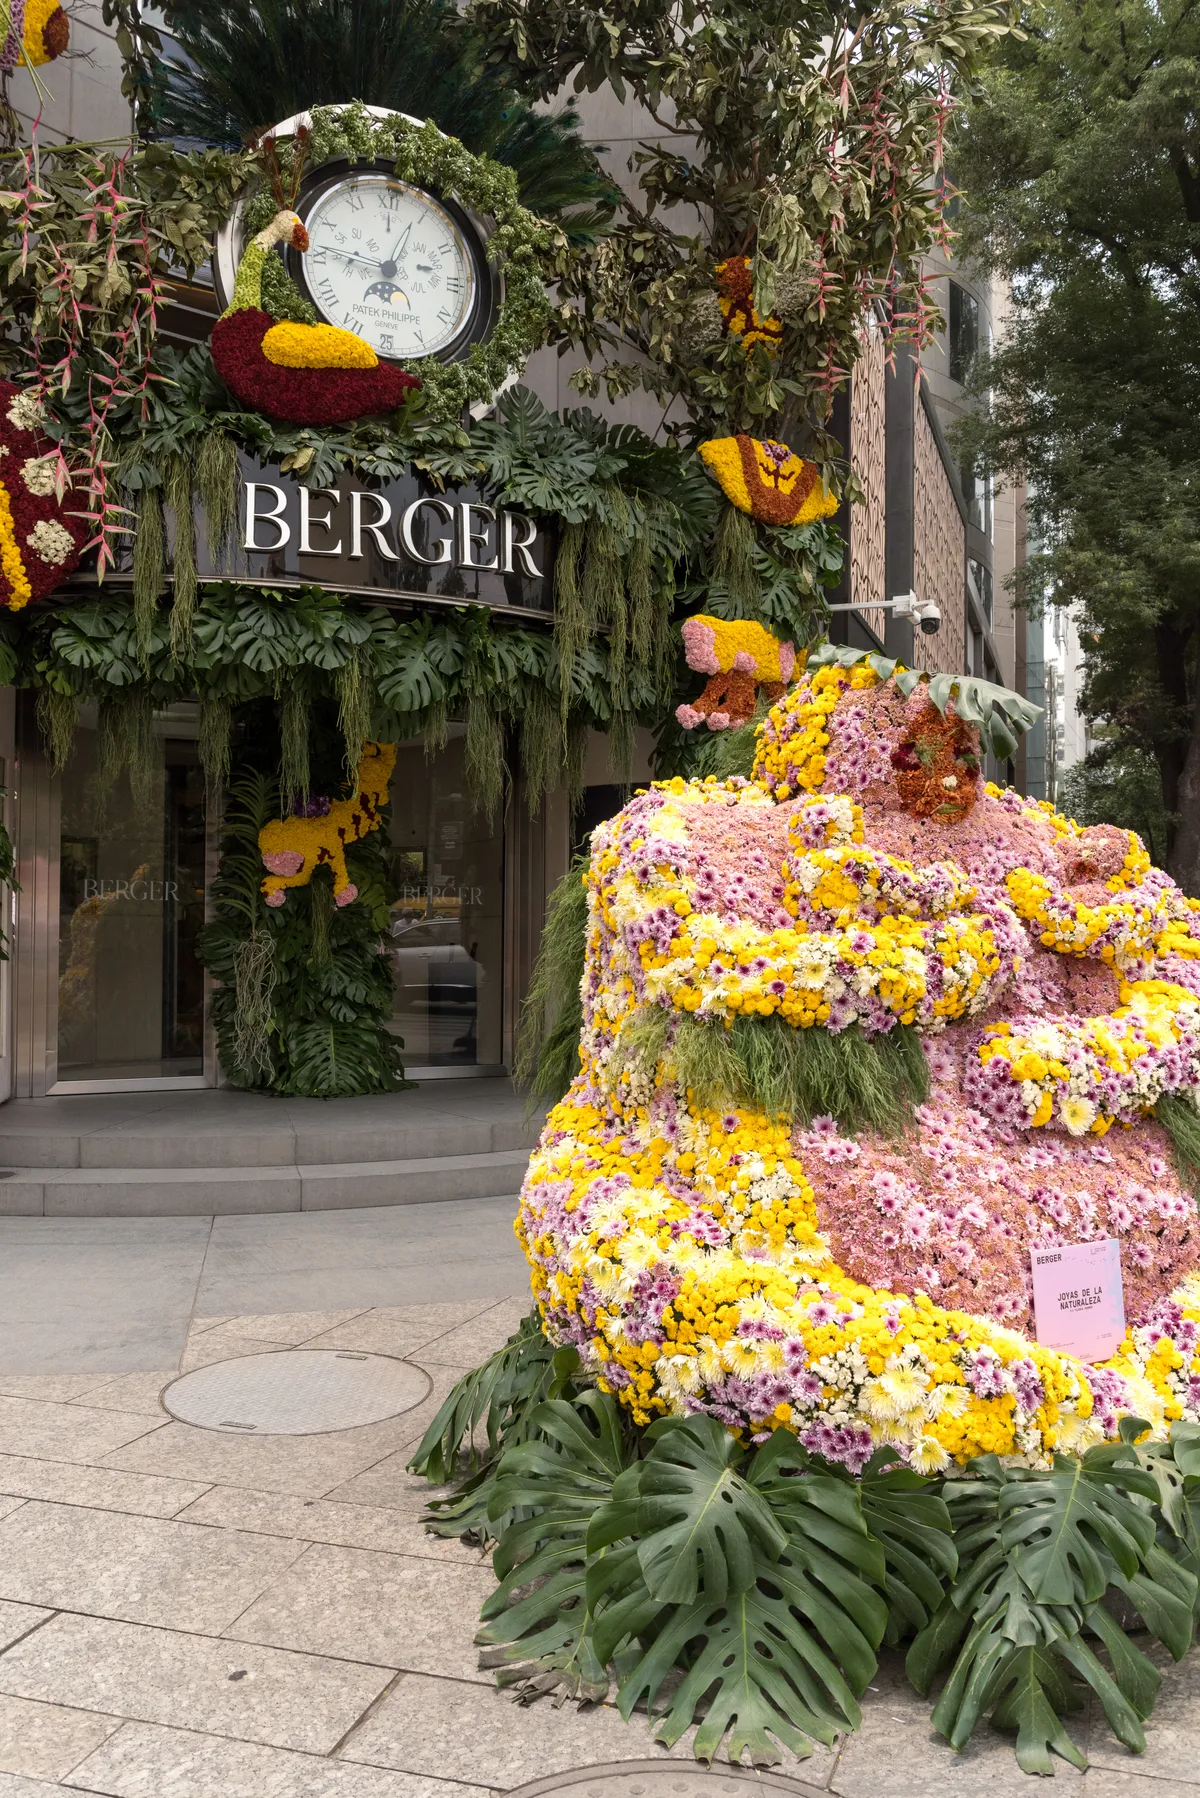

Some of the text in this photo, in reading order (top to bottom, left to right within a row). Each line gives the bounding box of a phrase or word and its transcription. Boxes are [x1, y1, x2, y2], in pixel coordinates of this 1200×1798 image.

[345, 195, 365, 213] XI
[377, 194, 400, 211] XII
[321, 217, 337, 232] X
[334, 231, 348, 245] SA
[351, 227, 362, 240] SU
[365, 238, 380, 253] MO
[411, 241, 427, 254] JAN
[437, 243, 452, 255] II
[313, 248, 327, 265] IX
[427, 250, 443, 271] MAR
[341, 264, 354, 278] TH
[357, 267, 373, 280] WE
[410, 282, 427, 294] JUL
[427, 271, 442, 289] MAY
[446, 276, 459, 295] III
[318, 277, 340, 308] VIII
[352, 303, 420, 326] PATEK PHILIPPE
[436, 305, 452, 326] IV
[341, 312, 365, 336] VII
[374, 320, 399, 331] GENEVE
[380, 335, 393, 351] 25
[243, 481, 545, 580] BERGER
[83, 879, 180, 901] BERGER
[403, 885, 484, 905] BERGER
[1036, 1253, 1062, 1265] BERGER
[1057, 1286, 1103, 1302] JOYAS DE LA
[1060, 1295, 1102, 1310] NATURALEZA
